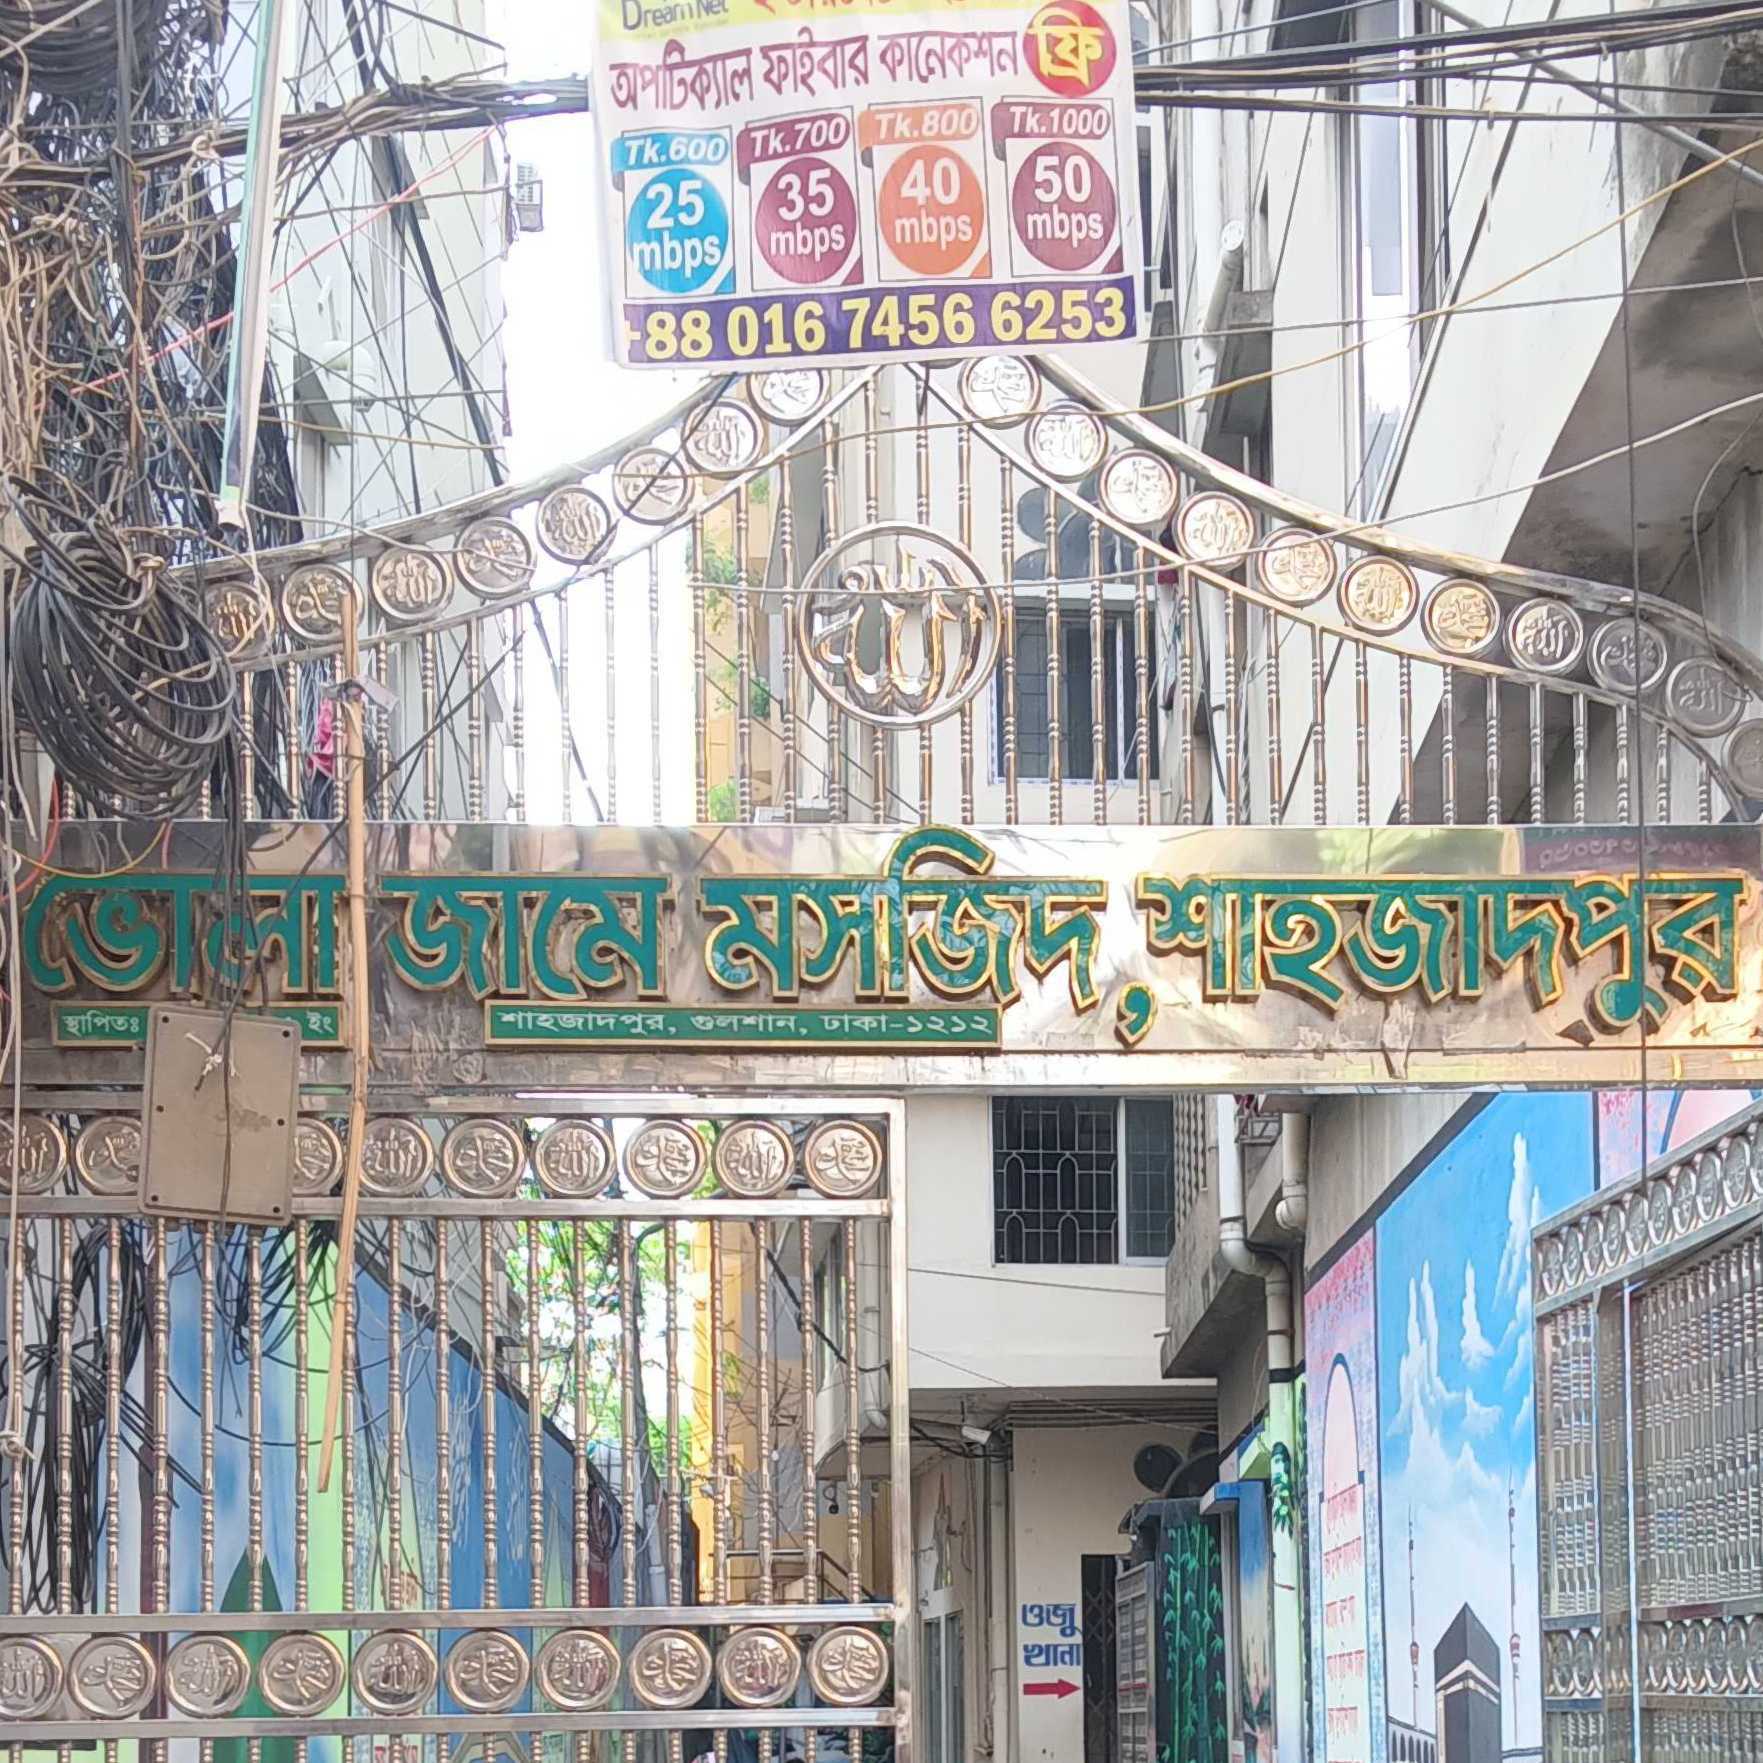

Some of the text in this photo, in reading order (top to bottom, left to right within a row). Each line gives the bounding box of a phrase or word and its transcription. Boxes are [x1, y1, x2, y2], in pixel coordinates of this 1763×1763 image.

[609, 26, 1019, 111] অপটিক্যাল ফাইবার কানেকশন
[1028, 6, 1108, 90] ফ্রি
[750, 116, 848, 158] Tk.700
[874, 108, 980, 139] Tk.800
[1009, 105, 1110, 137] Tk.1000
[625, 136, 728, 171] Tk.600
[777, 168, 836, 222] 35
[901, 157, 961, 206] 40
[1034, 154, 1092, 204] 50
[645, 181, 706, 230] 25
[770, 219, 846, 263] mbps
[895, 215, 973, 256] mbps
[1026, 206, 1105, 249] mbps
[632, 233, 722, 281] mbps
[727, 300, 826, 356] 016
[841, 291, 974, 350] 7456
[991, 286, 1127, 343] 6253
[377, 871, 672, 1000] জামে
[1137, 873, 1750, 1028] শাহজাদপুর
[306, 1011, 335, 1032] ইং
[498, 1010, 993, 1036] শাহজাদপুর, গুলশান, ঢাকা-১২১২
[1021, 1603, 1083, 1638] ওজু
[1023, 1643, 1082, 1667] খানা
